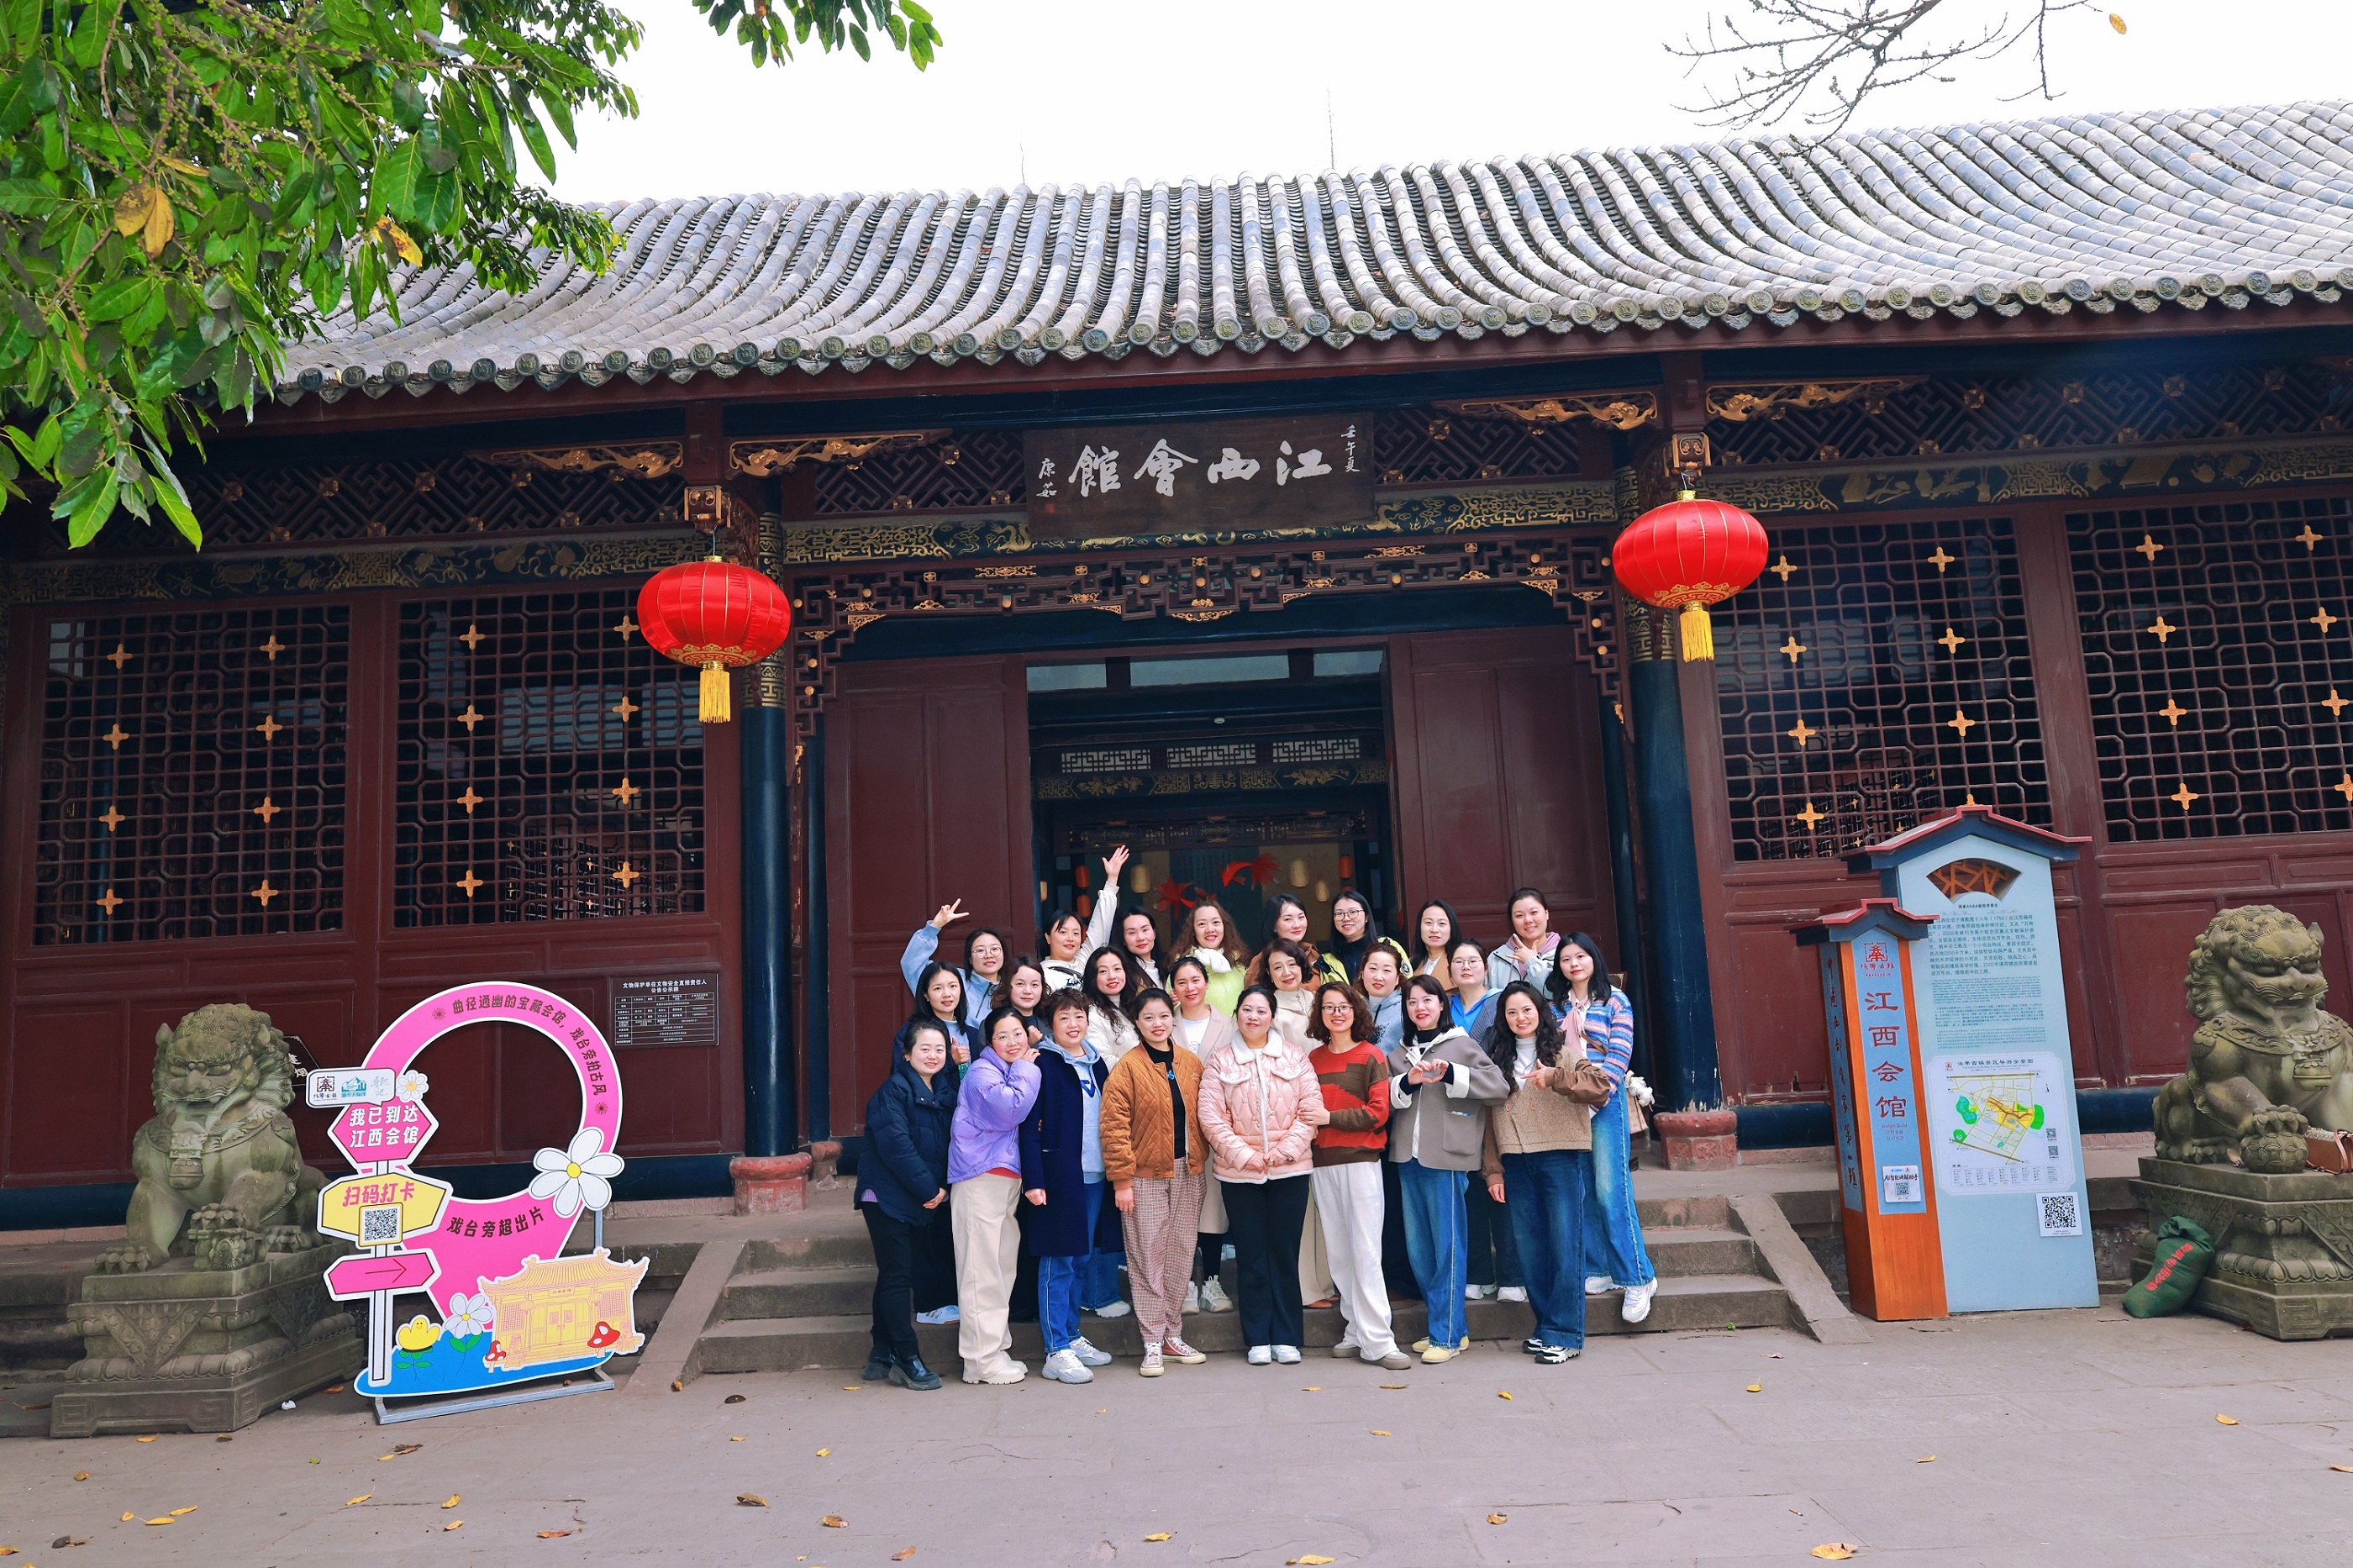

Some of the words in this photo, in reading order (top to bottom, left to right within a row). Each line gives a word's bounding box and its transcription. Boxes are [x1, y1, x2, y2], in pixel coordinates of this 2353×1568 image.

[1865, 992, 1908, 1118] 江西会馆
[350, 1105, 419, 1127] 我已到达
[349, 1126, 419, 1149] 江西会馆
[343, 1181, 415, 1207] 扫码打卡
[446, 1206, 545, 1239] 戏台旁超出片
